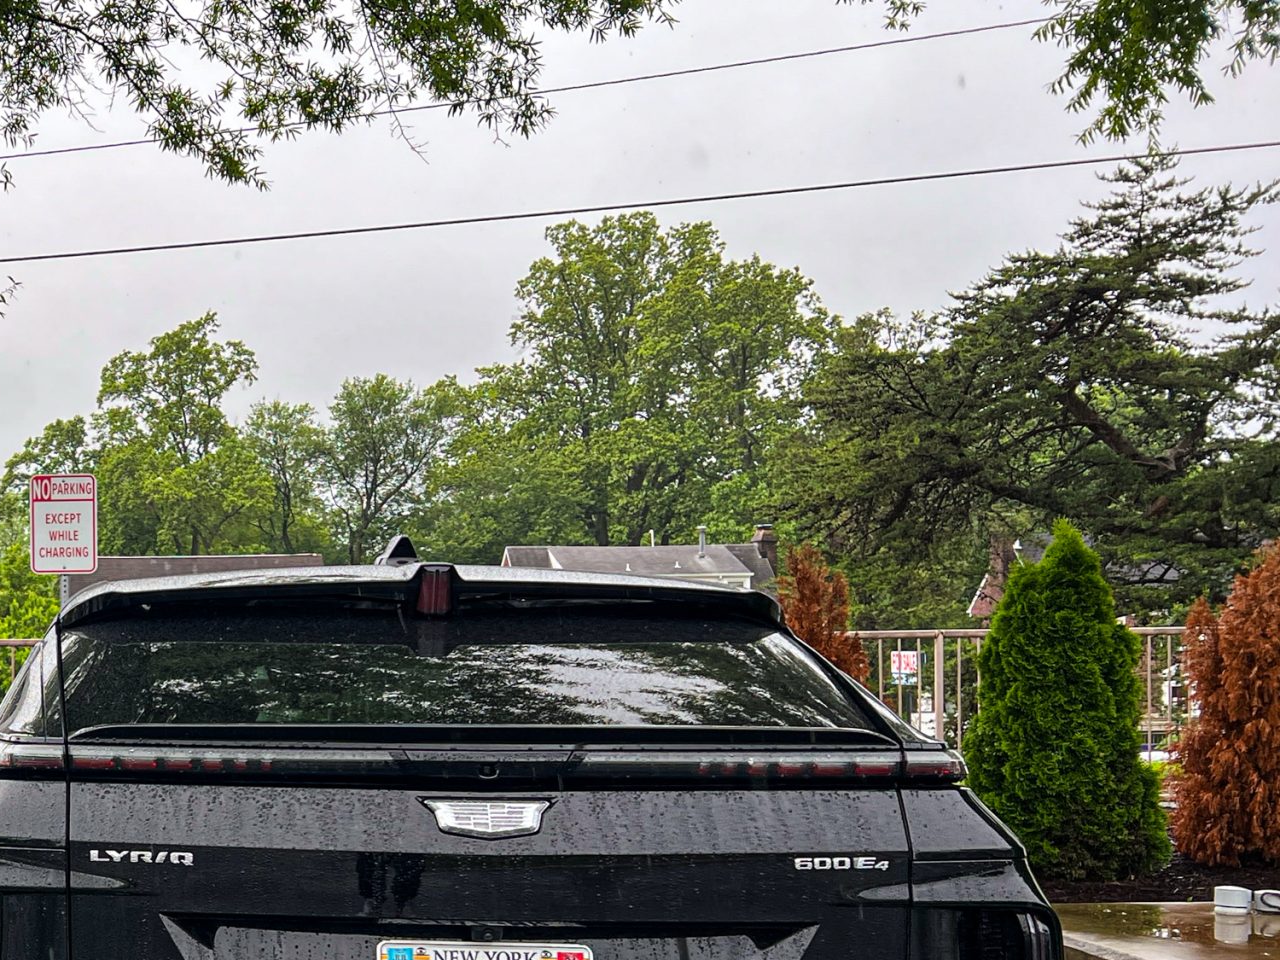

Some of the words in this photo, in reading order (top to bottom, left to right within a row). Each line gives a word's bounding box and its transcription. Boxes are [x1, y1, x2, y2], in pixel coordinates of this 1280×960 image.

[33, 479, 51, 500] NO
[52, 482, 92, 495] PARKING
[45, 513, 81, 525] EXCEPT
[49, 530, 79, 541] WHILE
[39, 547, 89, 558] CHARGING
[89, 850, 194, 866] LYRIQ
